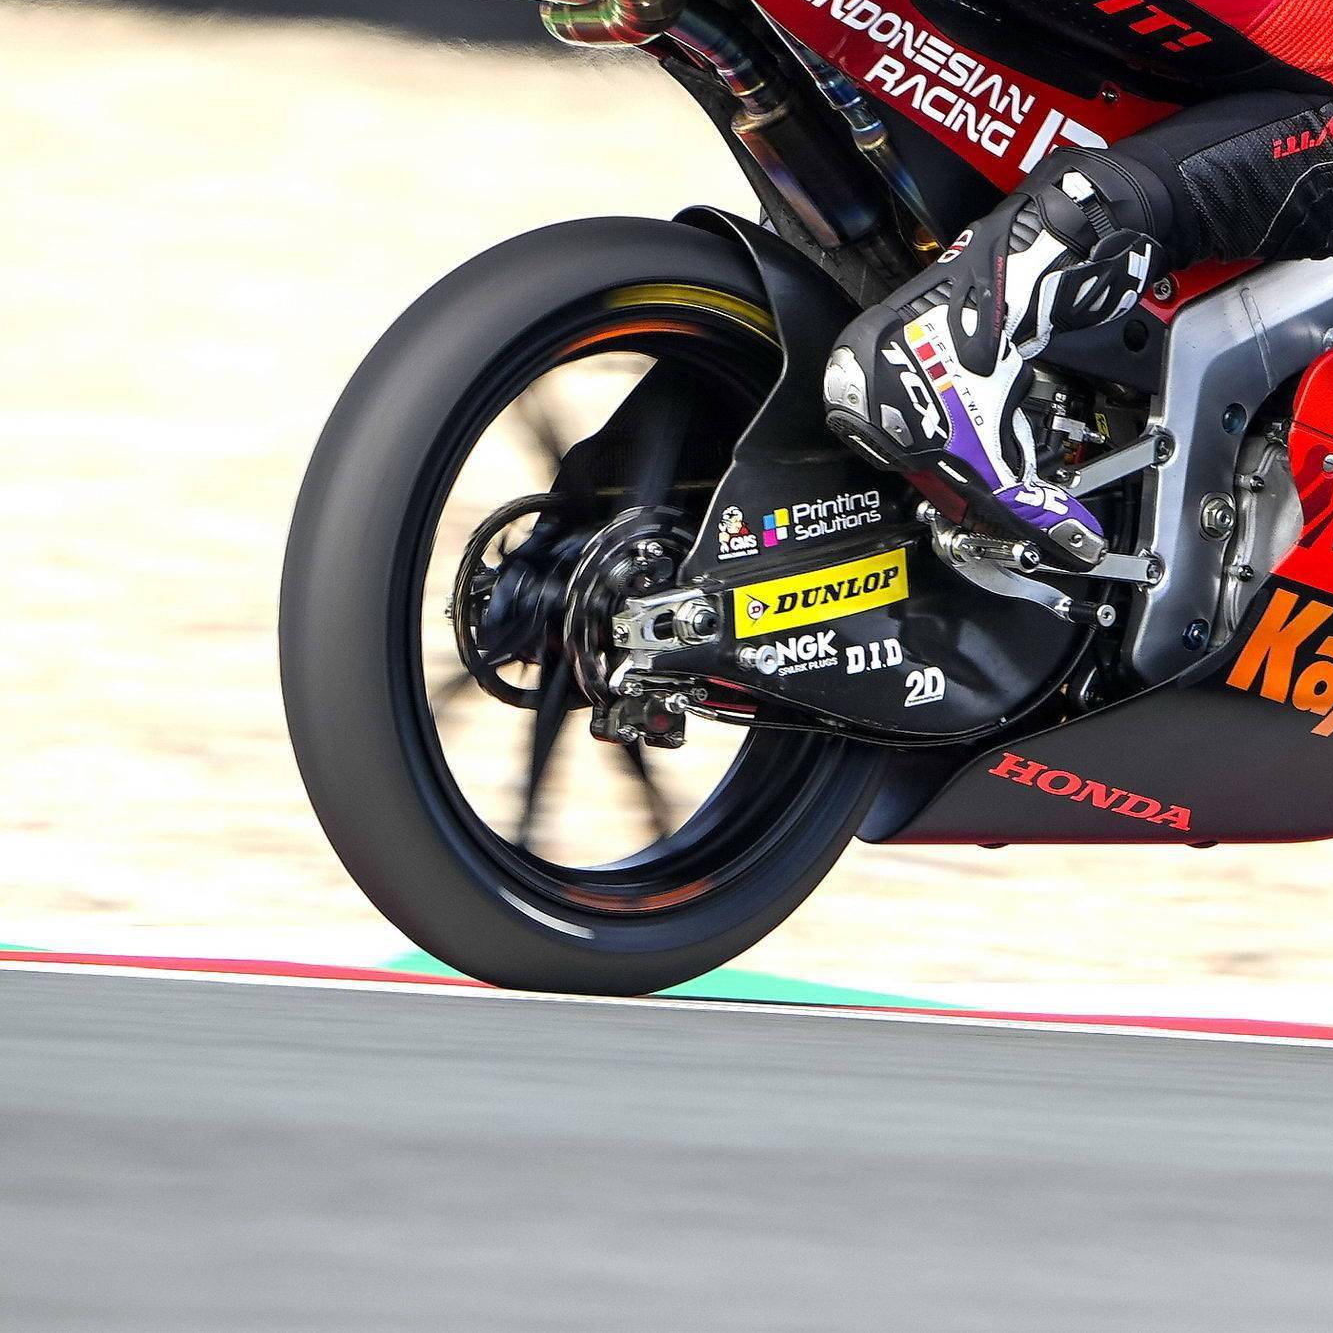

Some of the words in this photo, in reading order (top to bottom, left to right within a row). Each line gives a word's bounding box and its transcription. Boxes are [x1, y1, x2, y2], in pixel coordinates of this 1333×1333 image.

[863, 53, 1016, 158] RACING
[880, 340, 948, 440] TCX
[962, 387, 984, 427] TWO
[792, 490, 881, 524] Printing
[794, 509, 882, 541] Solutions
[773, 565, 899, 615] DUNLOP
[775, 629, 839, 665] NGK
[808, 656, 839, 673] PLUGS
[845, 637, 904, 675] D.I.D
[904, 666, 946, 707] 2D
[987, 751, 1193, 832] HONDA
